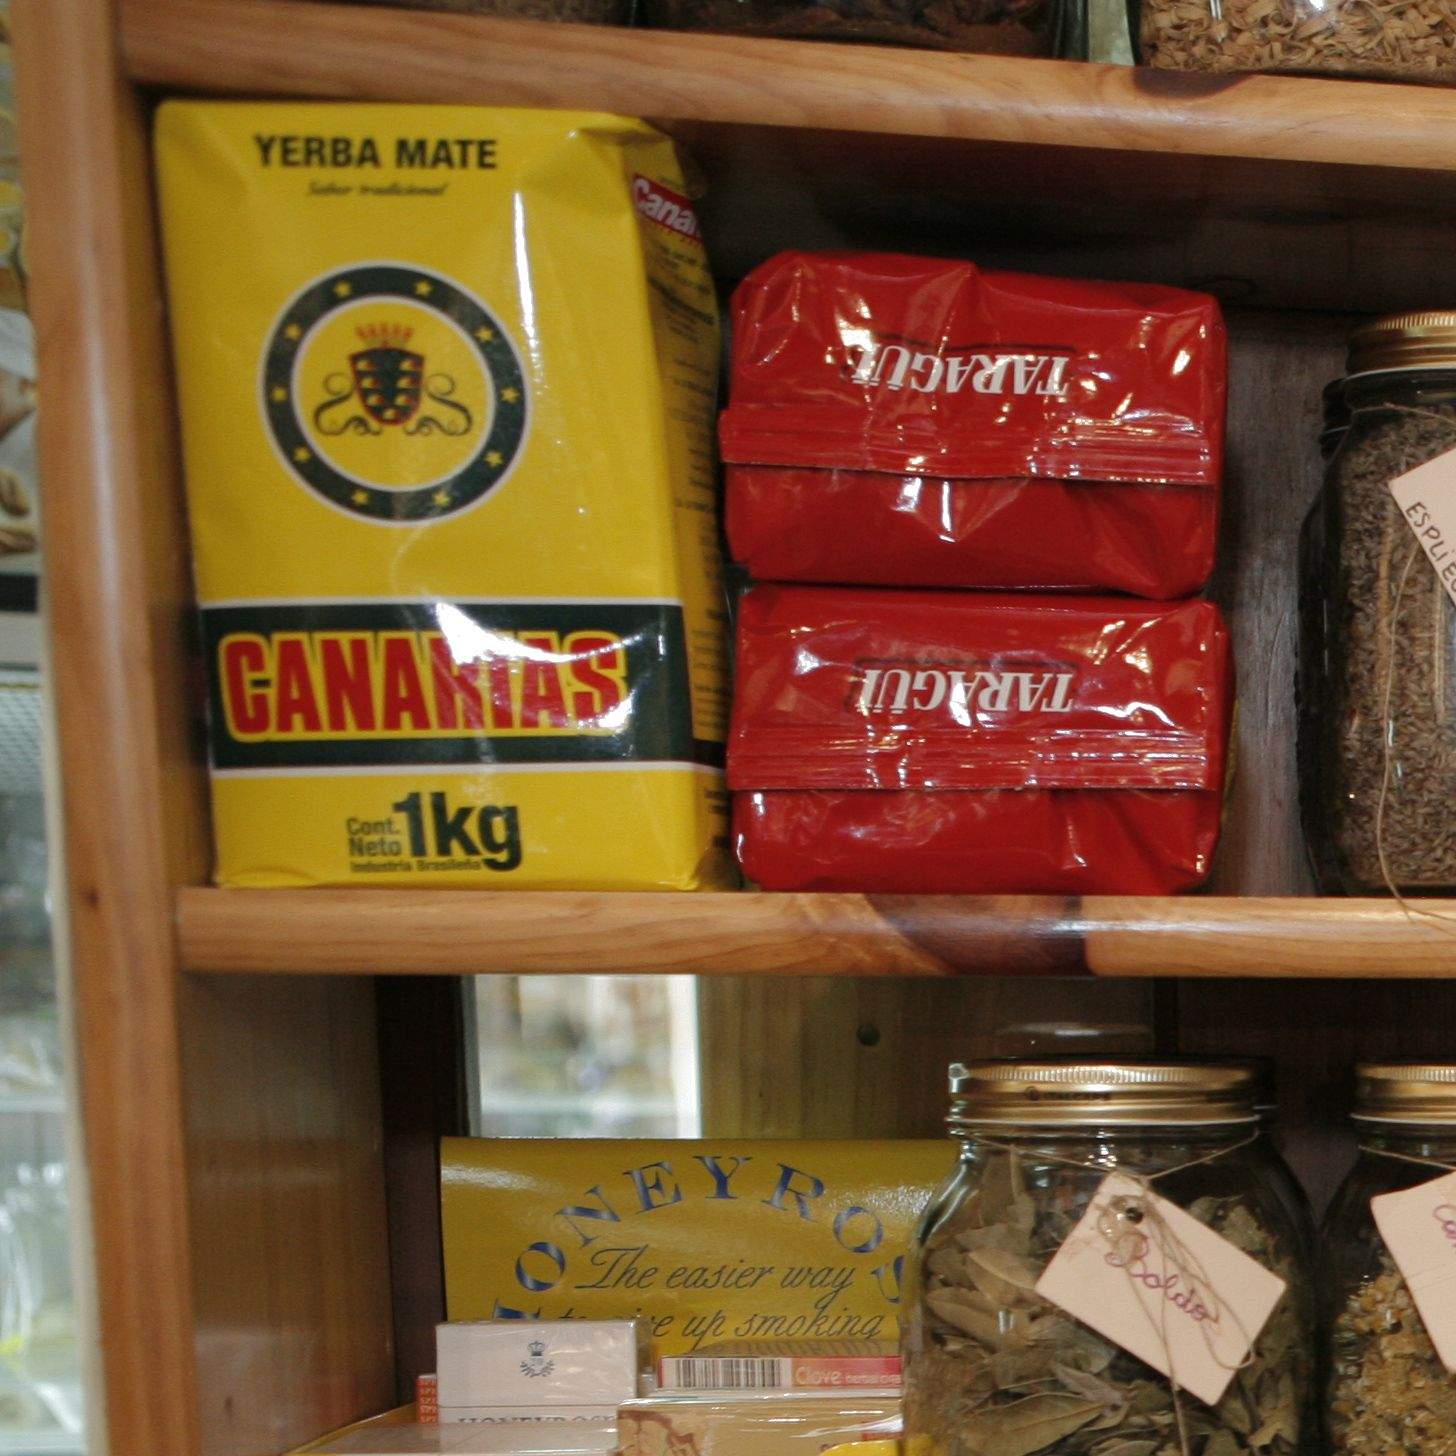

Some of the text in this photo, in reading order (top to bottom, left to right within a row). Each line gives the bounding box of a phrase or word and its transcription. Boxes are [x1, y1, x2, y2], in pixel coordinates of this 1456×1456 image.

[254, 134, 497, 169] YERBA MATE
[217, 631, 631, 743] CANARIAS
[346, 817, 399, 837] Cont.
[349, 837, 400, 857] Neto
[392, 791, 523, 872] 1kg
[575, 1244, 857, 1312] The easier way
[683, 1314, 727, 1350] up
[735, 1307, 884, 1341] smoking
